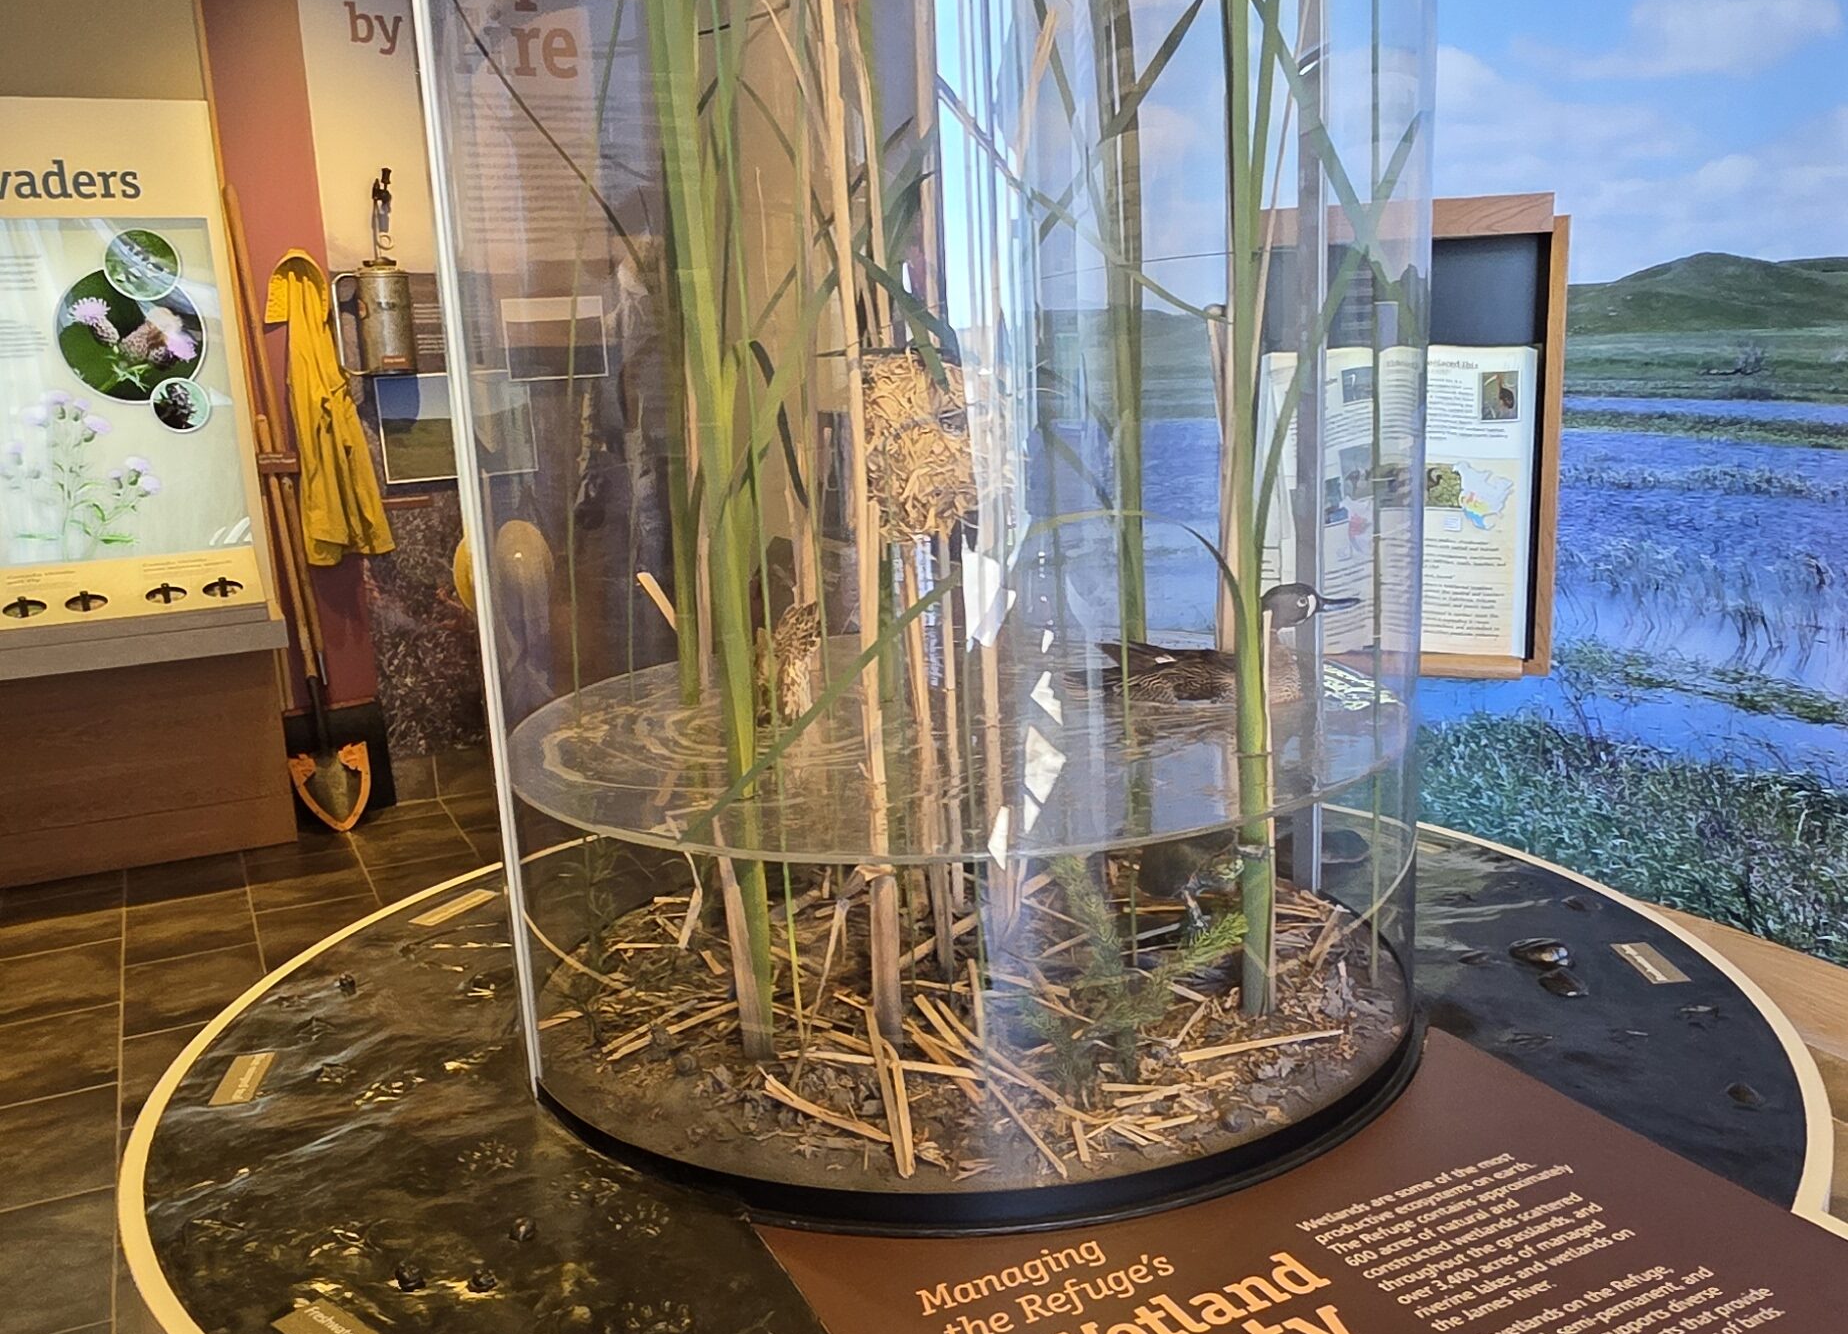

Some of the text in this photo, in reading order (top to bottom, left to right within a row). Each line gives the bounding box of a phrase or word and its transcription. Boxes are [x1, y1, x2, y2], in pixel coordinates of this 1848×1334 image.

[344, 1, 403, 55] by
[1296, 1202, 1370, 1232] Wetlands
[1370, 1194, 1396, 1207] are
[1394, 1180, 1435, 1198] some
[1434, 1172, 1453, 1184] of
[1451, 1165, 1479, 1178] the
[1314, 1161, 1537, 1245] productive ecosystems on earth.
[1327, 1164, 1574, 1254] The Refuge contains approximately
[1345, 1198, 1520, 1267] 600 acres of natural and
[1363, 1192, 1583, 1279] constructed wetlands scattered
[1378, 1201, 1603, 1292] throughout the grasslands, and
[1397, 1219, 1606, 1305] over 3,400 acres of managed
[916, 1240, 1107, 1316] Managing
[1015, 1254, 1175, 1324] Refuge's
[1414, 1228, 1636, 1319] riverine lakes and wetlands on
[1430, 1279, 1557, 1332] the James River.
[1562, 1299, 1588, 1312] on
[1584, 1287, 1616, 1304] the
[1610, 1265, 1675, 1292] Refuge,
[1667, 1286, 1723, 1313] diverse
[1681, 1265, 1714, 1285] and
[1679, 1311, 1719, 1331] that
[1714, 1287, 1774, 1318] provide
[1735, 1307, 1786, 1329] birds.
